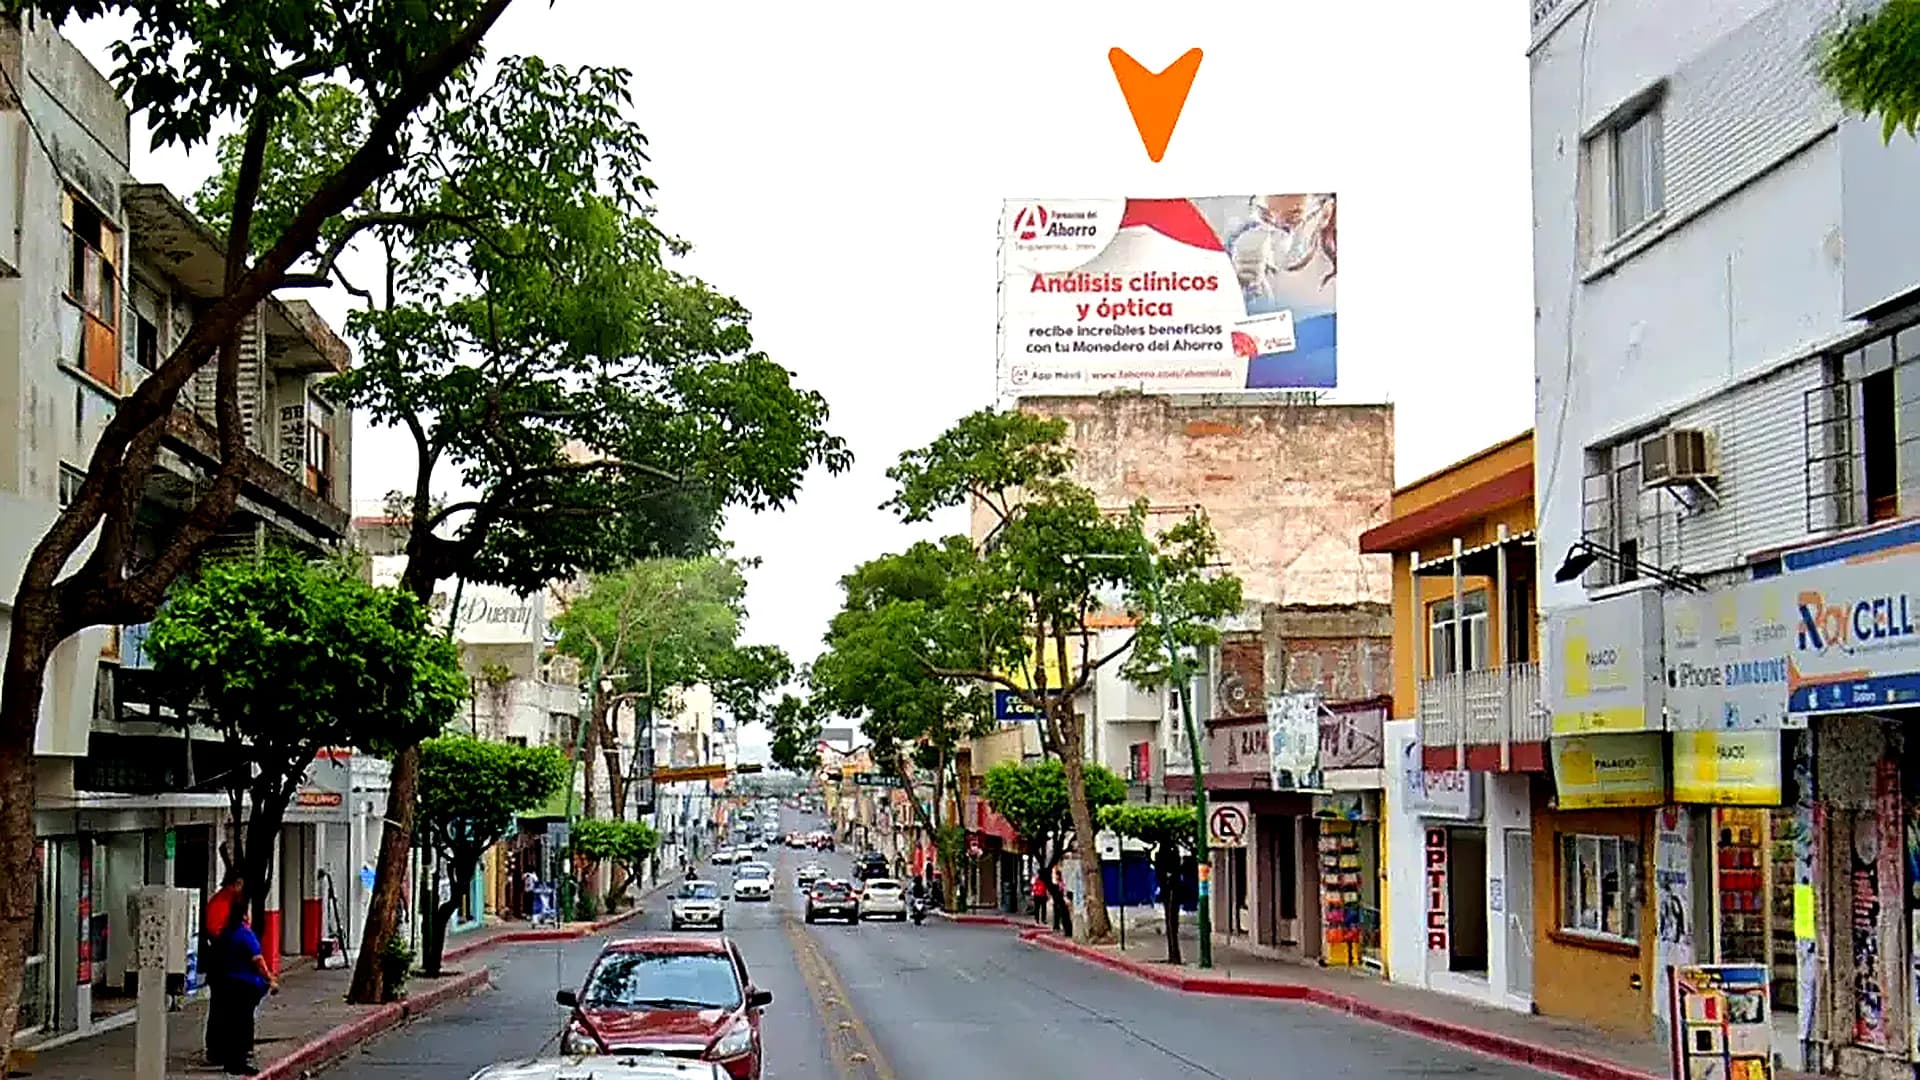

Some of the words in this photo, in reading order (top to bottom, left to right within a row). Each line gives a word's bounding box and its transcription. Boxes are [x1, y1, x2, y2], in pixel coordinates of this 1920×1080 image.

[1046, 221, 1097, 236] Ahorro
[1030, 272, 1123, 293] Análisis
[1129, 271, 1219, 291] clínicos
[1076, 302, 1090, 320] y
[1096, 297, 1174, 320] óptica
[1029, 325, 1074, 337] recibe
[1077, 324, 1145, 337] increíbles
[1148, 323, 1223, 336] beneficios
[1026, 342, 1052, 354] con
[1055, 341, 1070, 353] tu
[1072, 340, 1145, 353] Monedero
[1147, 339, 1170, 352] del
[1172, 338, 1224, 351] Ahorro
[1679, 662, 1722, 687] iPhone
[1426, 828, 1447, 950] OPTICA
